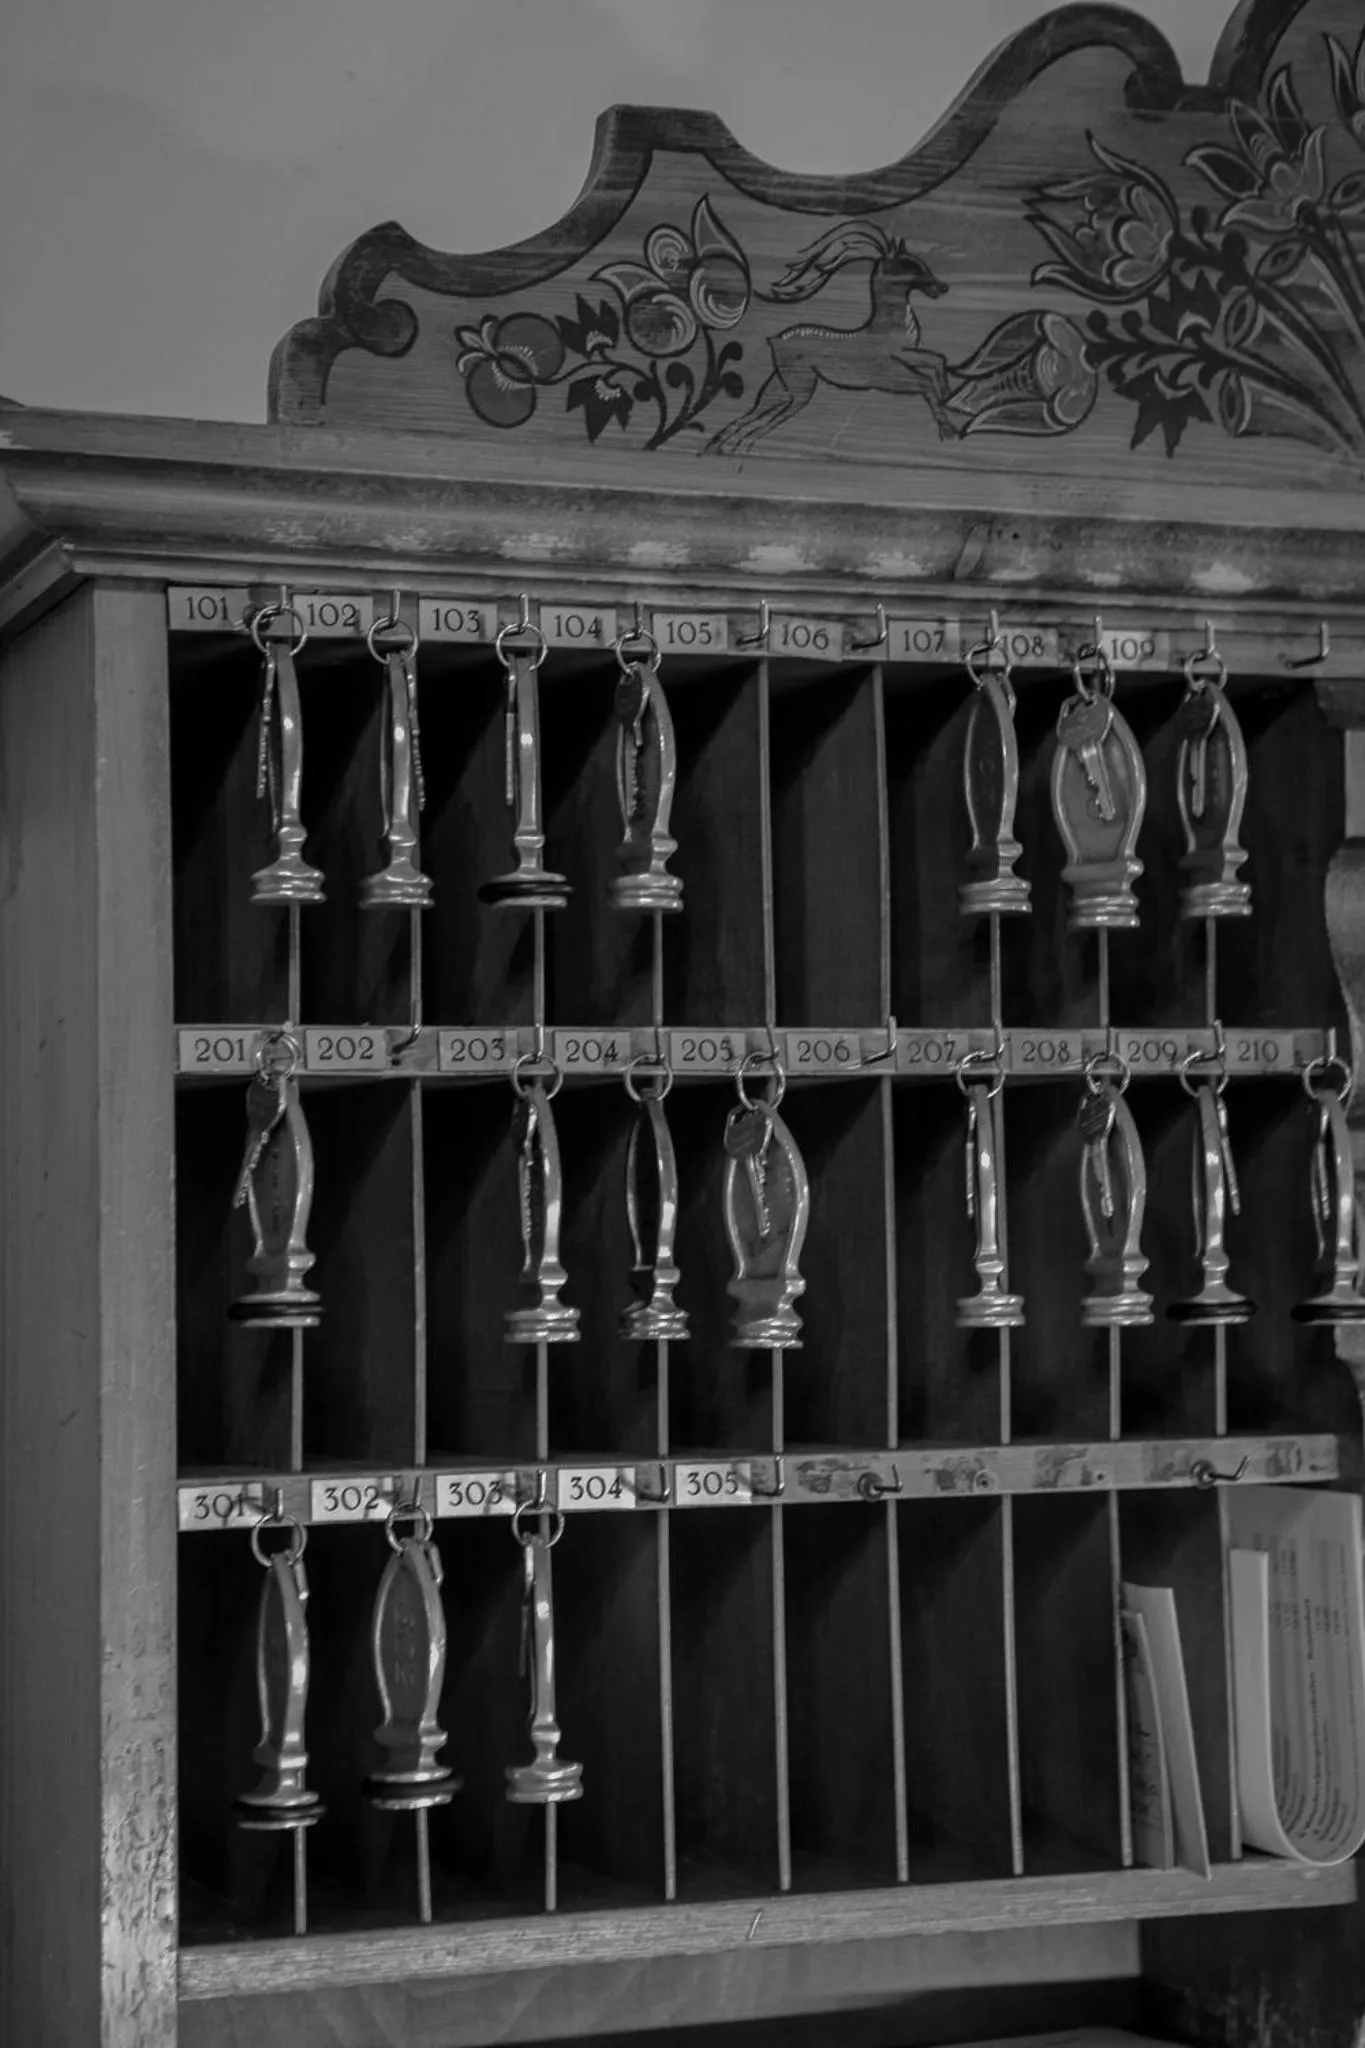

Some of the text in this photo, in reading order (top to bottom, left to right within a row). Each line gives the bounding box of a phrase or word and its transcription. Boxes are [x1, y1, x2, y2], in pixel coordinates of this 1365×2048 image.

[186, 595, 229, 621] 101
[306, 602, 359, 628] 102
[432, 607, 481, 633] 103
[554, 613, 601, 640] 104
[666, 621, 713, 646] 105
[781, 623, 830, 650] 106
[903, 629, 945, 654] 107
[1003, 633, 1045, 658] 108
[1111, 637, 1156, 661] 109
[194, 1037, 245, 1062] 201
[316, 1036, 374, 1061] 202
[450, 1037, 505, 1062] 203
[565, 1038, 618, 1063] 204
[681, 1038, 735, 1063] 205
[796, 1039, 850, 1063] 206
[908, 1039, 956, 1064] 207
[1021, 1039, 1071, 1063] 208
[1127, 1039, 1179, 1065] 209
[1237, 1039, 1279, 1063] 210
[449, 1480, 503, 1507] 303
[569, 1475, 623, 1500] 304
[687, 1470, 739, 1497] 305
[323, 1485, 379, 1512] 302
